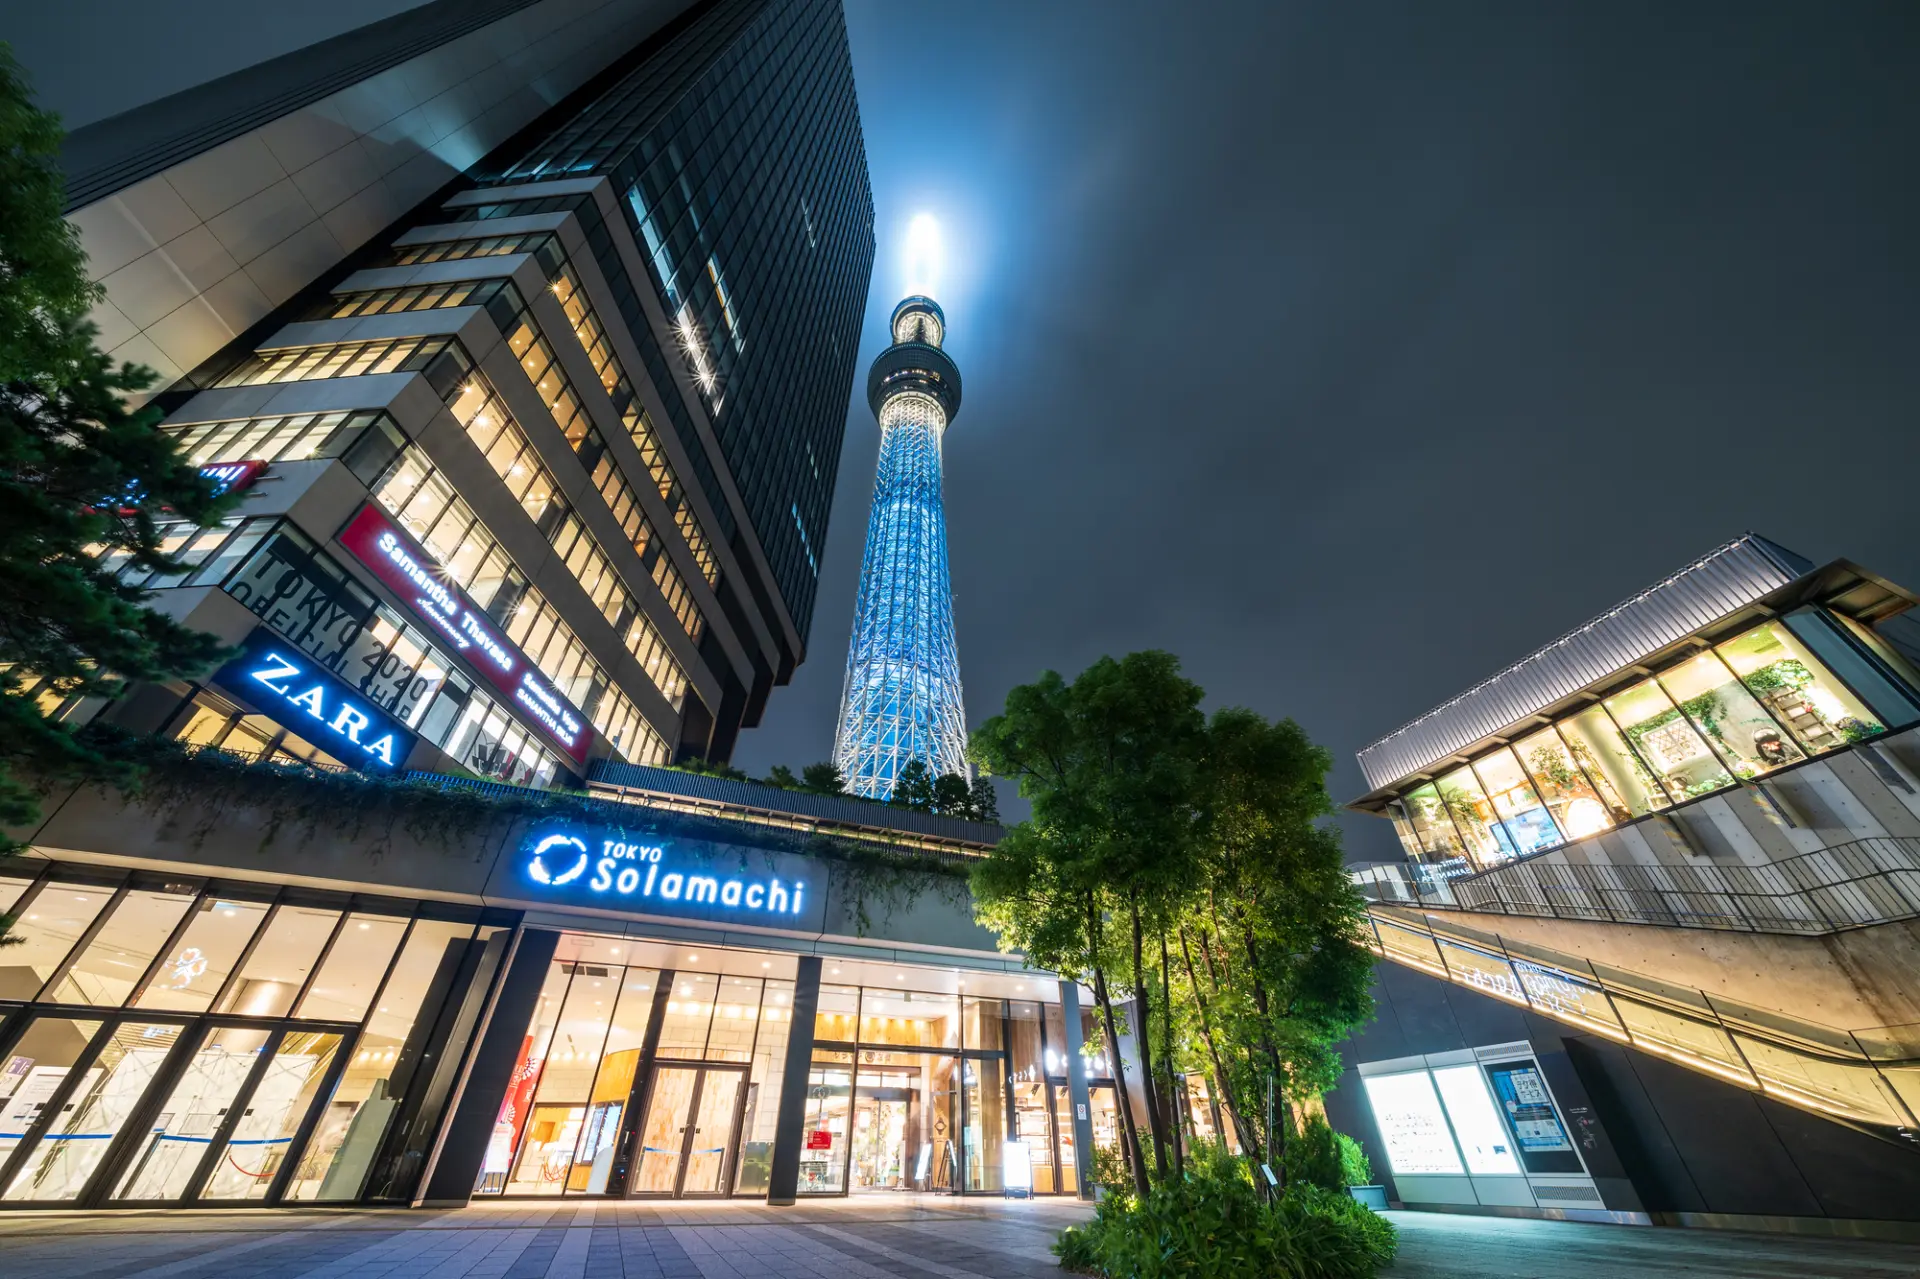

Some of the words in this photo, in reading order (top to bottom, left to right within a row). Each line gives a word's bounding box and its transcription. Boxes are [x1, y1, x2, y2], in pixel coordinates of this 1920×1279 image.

[255, 549, 363, 647] TOKYO
[361, 640, 429, 702] 2020
[378, 532, 458, 616] Samantha
[461, 611, 514, 671] Thavasa
[251, 652, 394, 767] ZARA
[516, 688, 556, 730] SAMANTHA
[523, 673, 561, 715] Samantha
[603, 841, 663, 863] TOKYO
[590, 857, 804, 915] Solamachi
